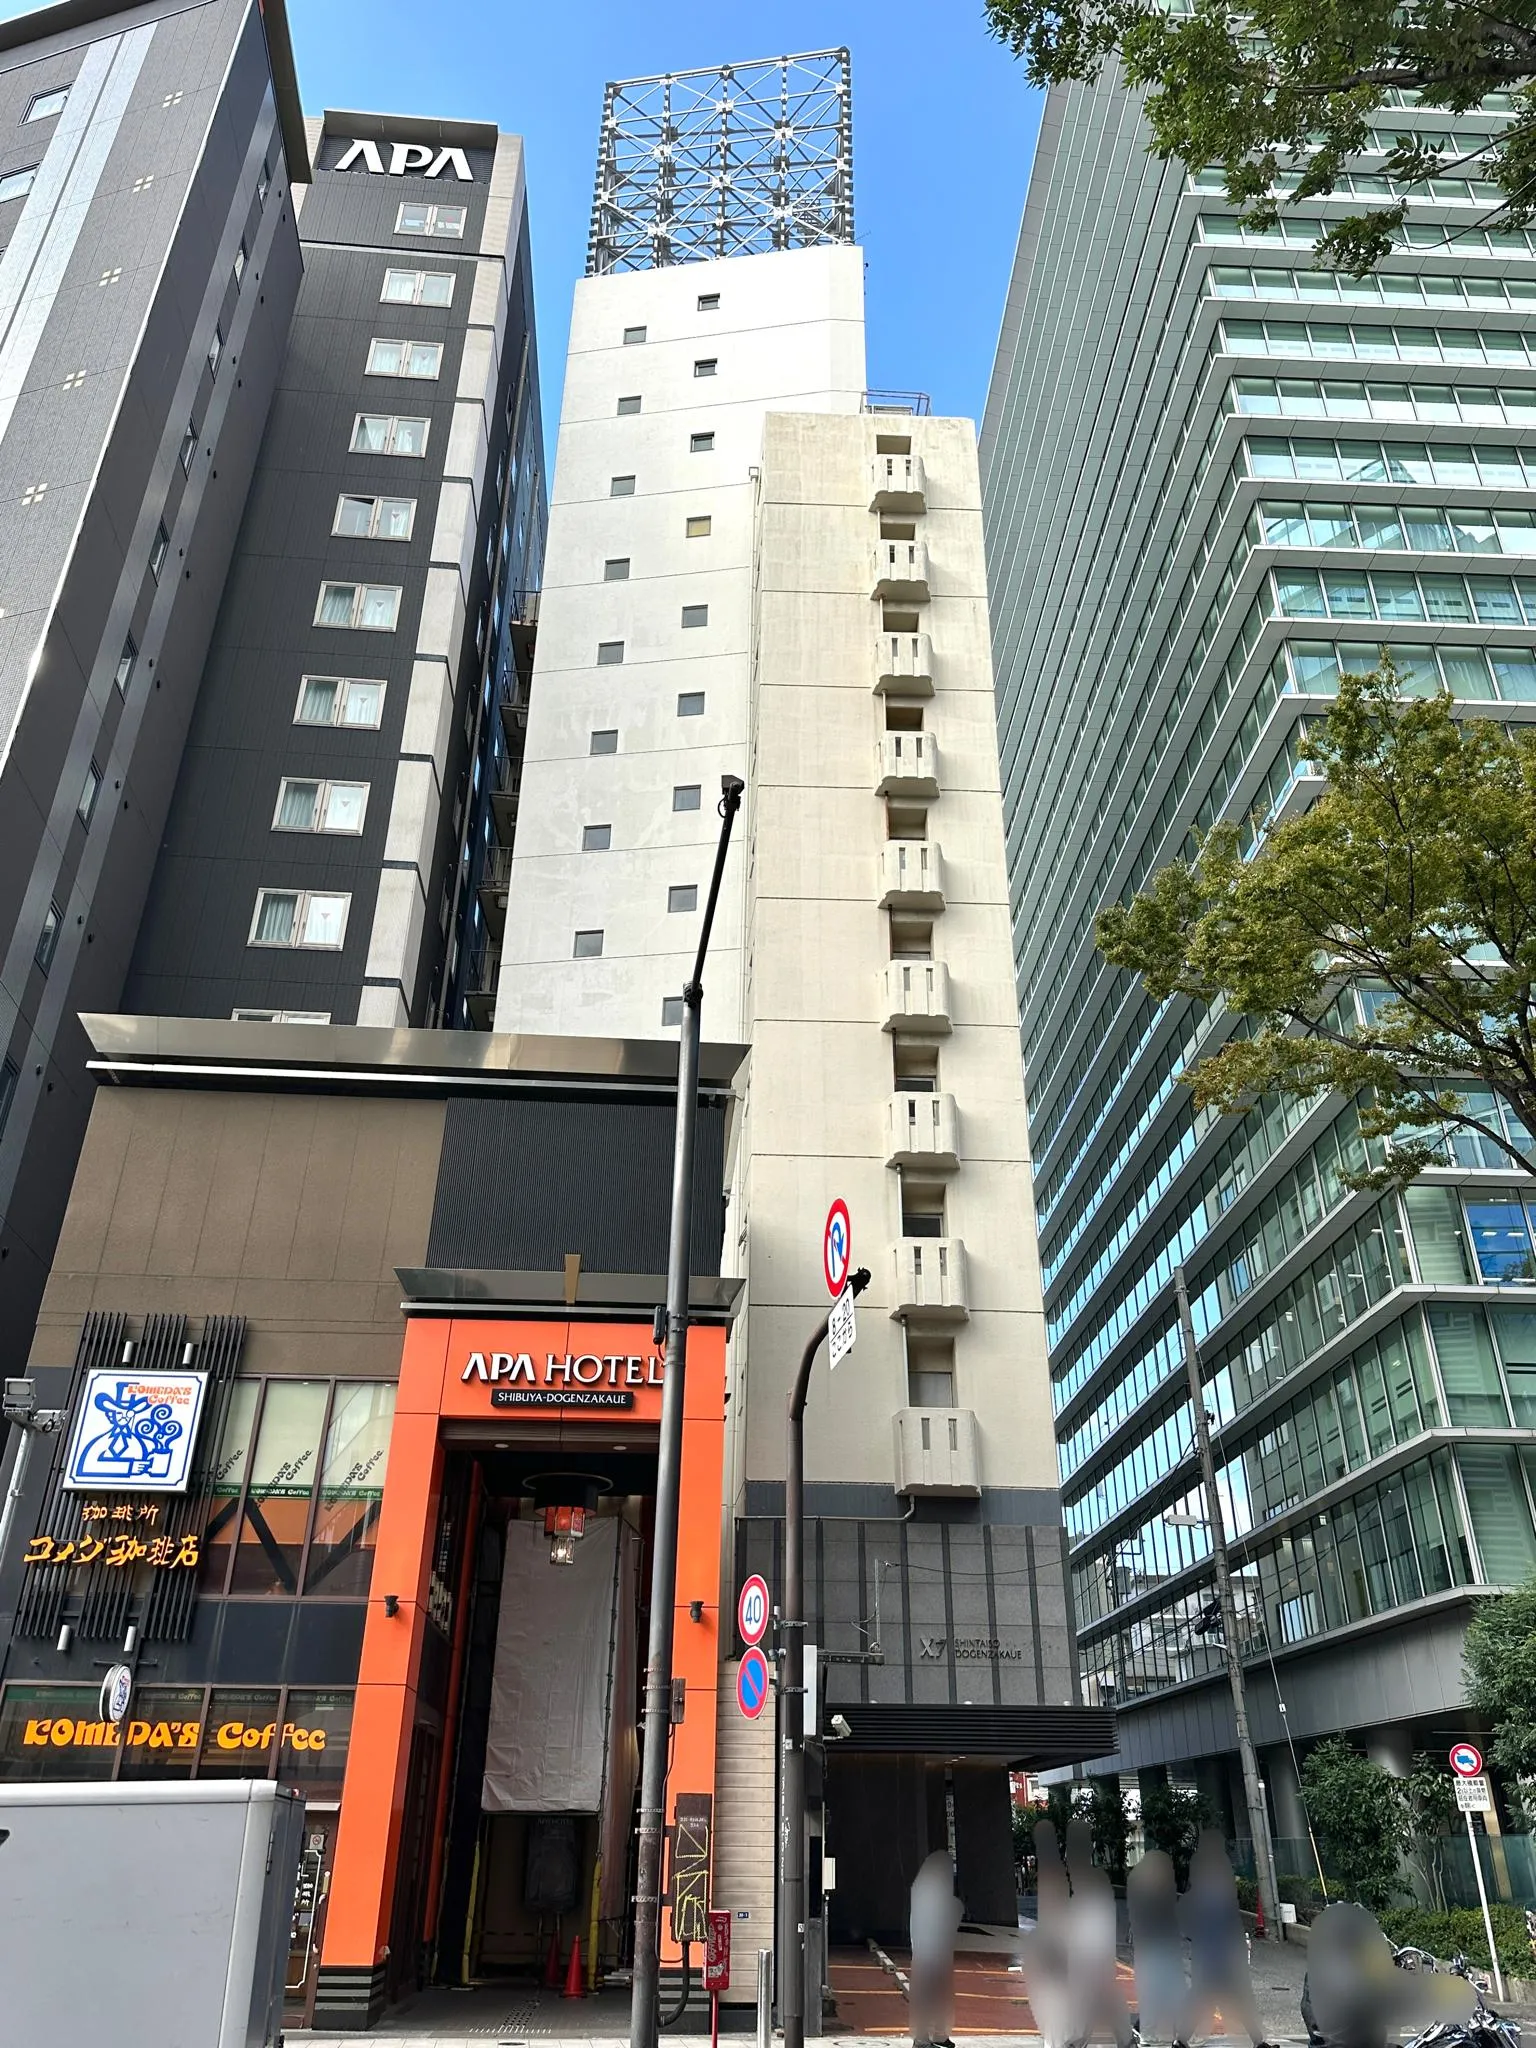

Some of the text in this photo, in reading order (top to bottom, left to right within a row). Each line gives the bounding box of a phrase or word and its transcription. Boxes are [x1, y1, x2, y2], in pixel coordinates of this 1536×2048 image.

[334, 138, 474, 181] APA
[832, 1321, 853, 1358] ここから
[461, 1352, 664, 1385] APA HOTEL
[148, 1395, 190, 1405] Coffee
[498, 1391, 626, 1404] SHIBUYA-DOGENZAKAUE
[216, 1449, 244, 1481] Coffee
[285, 1449, 313, 1481] Coffee
[357, 1450, 384, 1482] Coffee
[82, 1504, 160, 1526] 珈琲所
[745, 1594, 762, 1625] 40
[216, 1722, 326, 1751] Coffee
